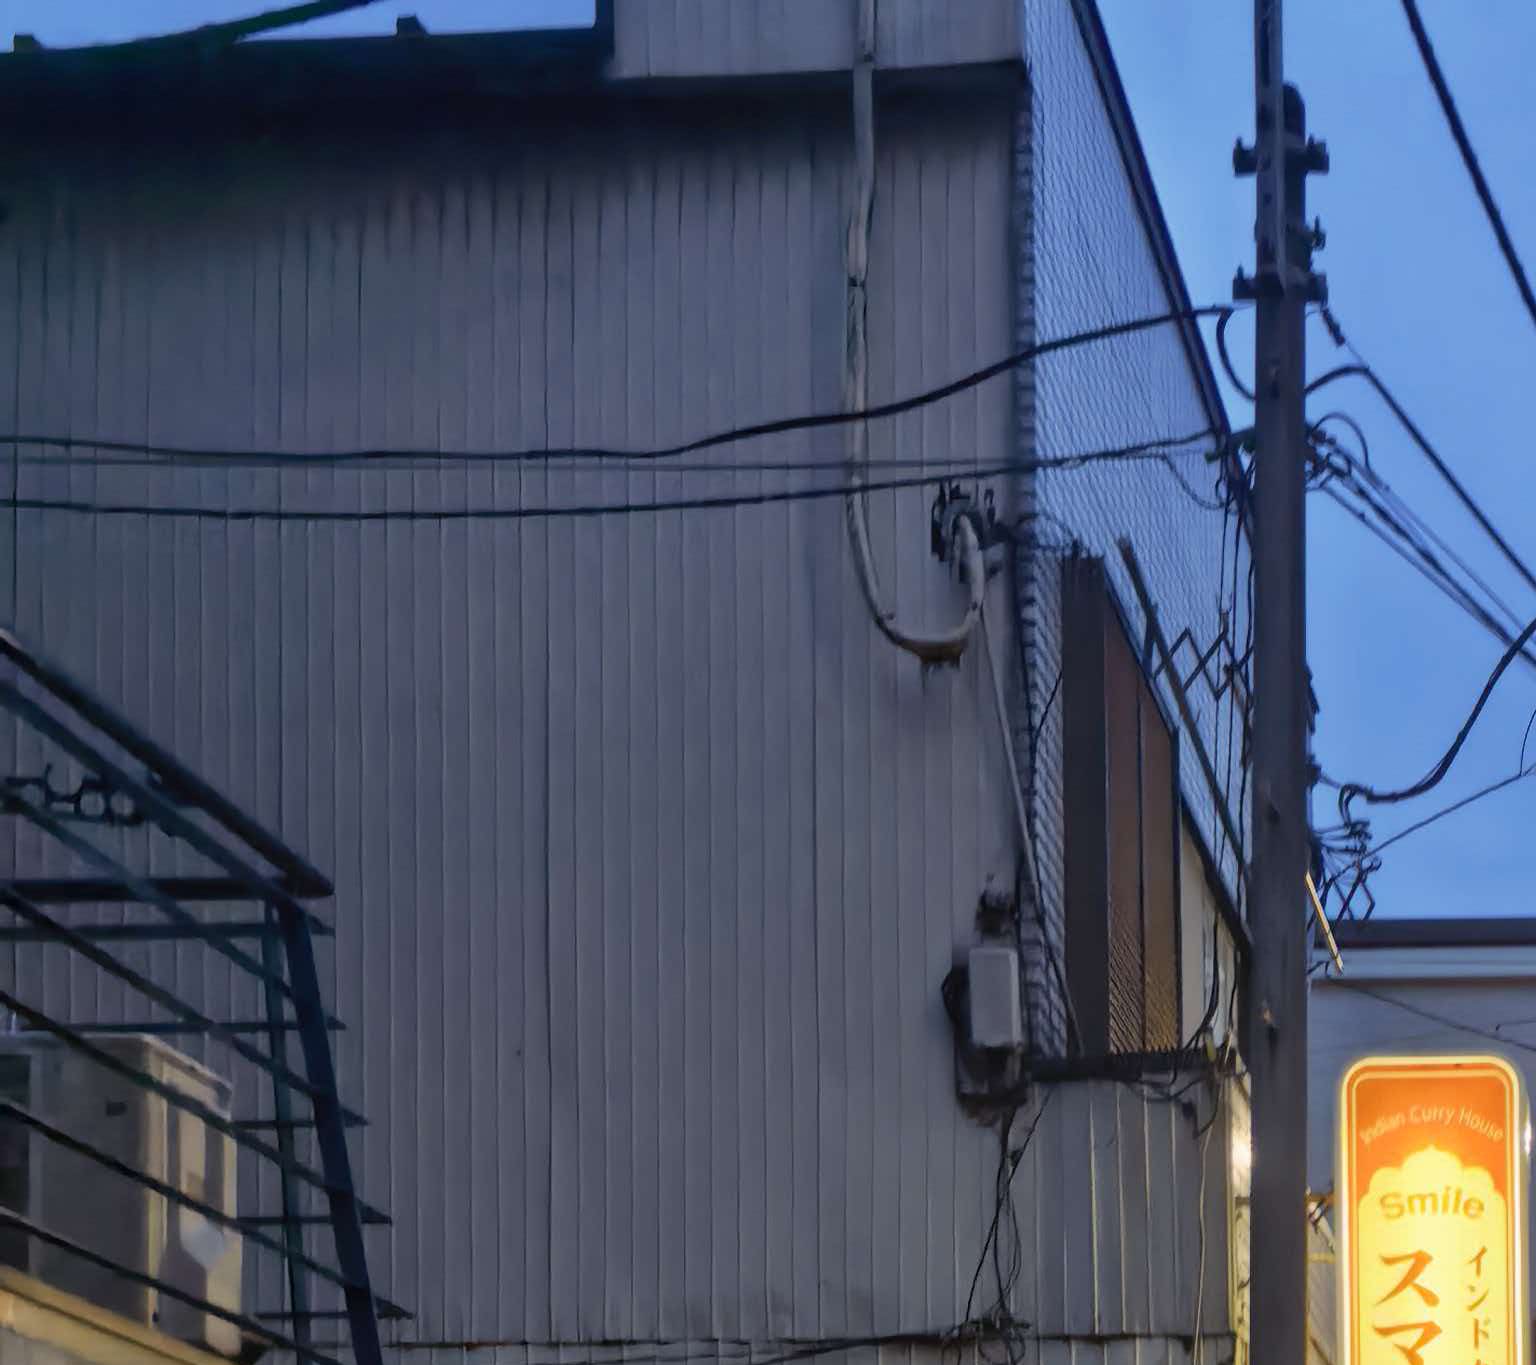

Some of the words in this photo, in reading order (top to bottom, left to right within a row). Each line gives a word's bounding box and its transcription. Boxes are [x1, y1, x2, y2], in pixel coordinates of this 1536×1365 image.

[1360, 1112, 1406, 1145] Indian
[1410, 1104, 1456, 1125] Curry
[1458, 1107, 1504, 1142] House
